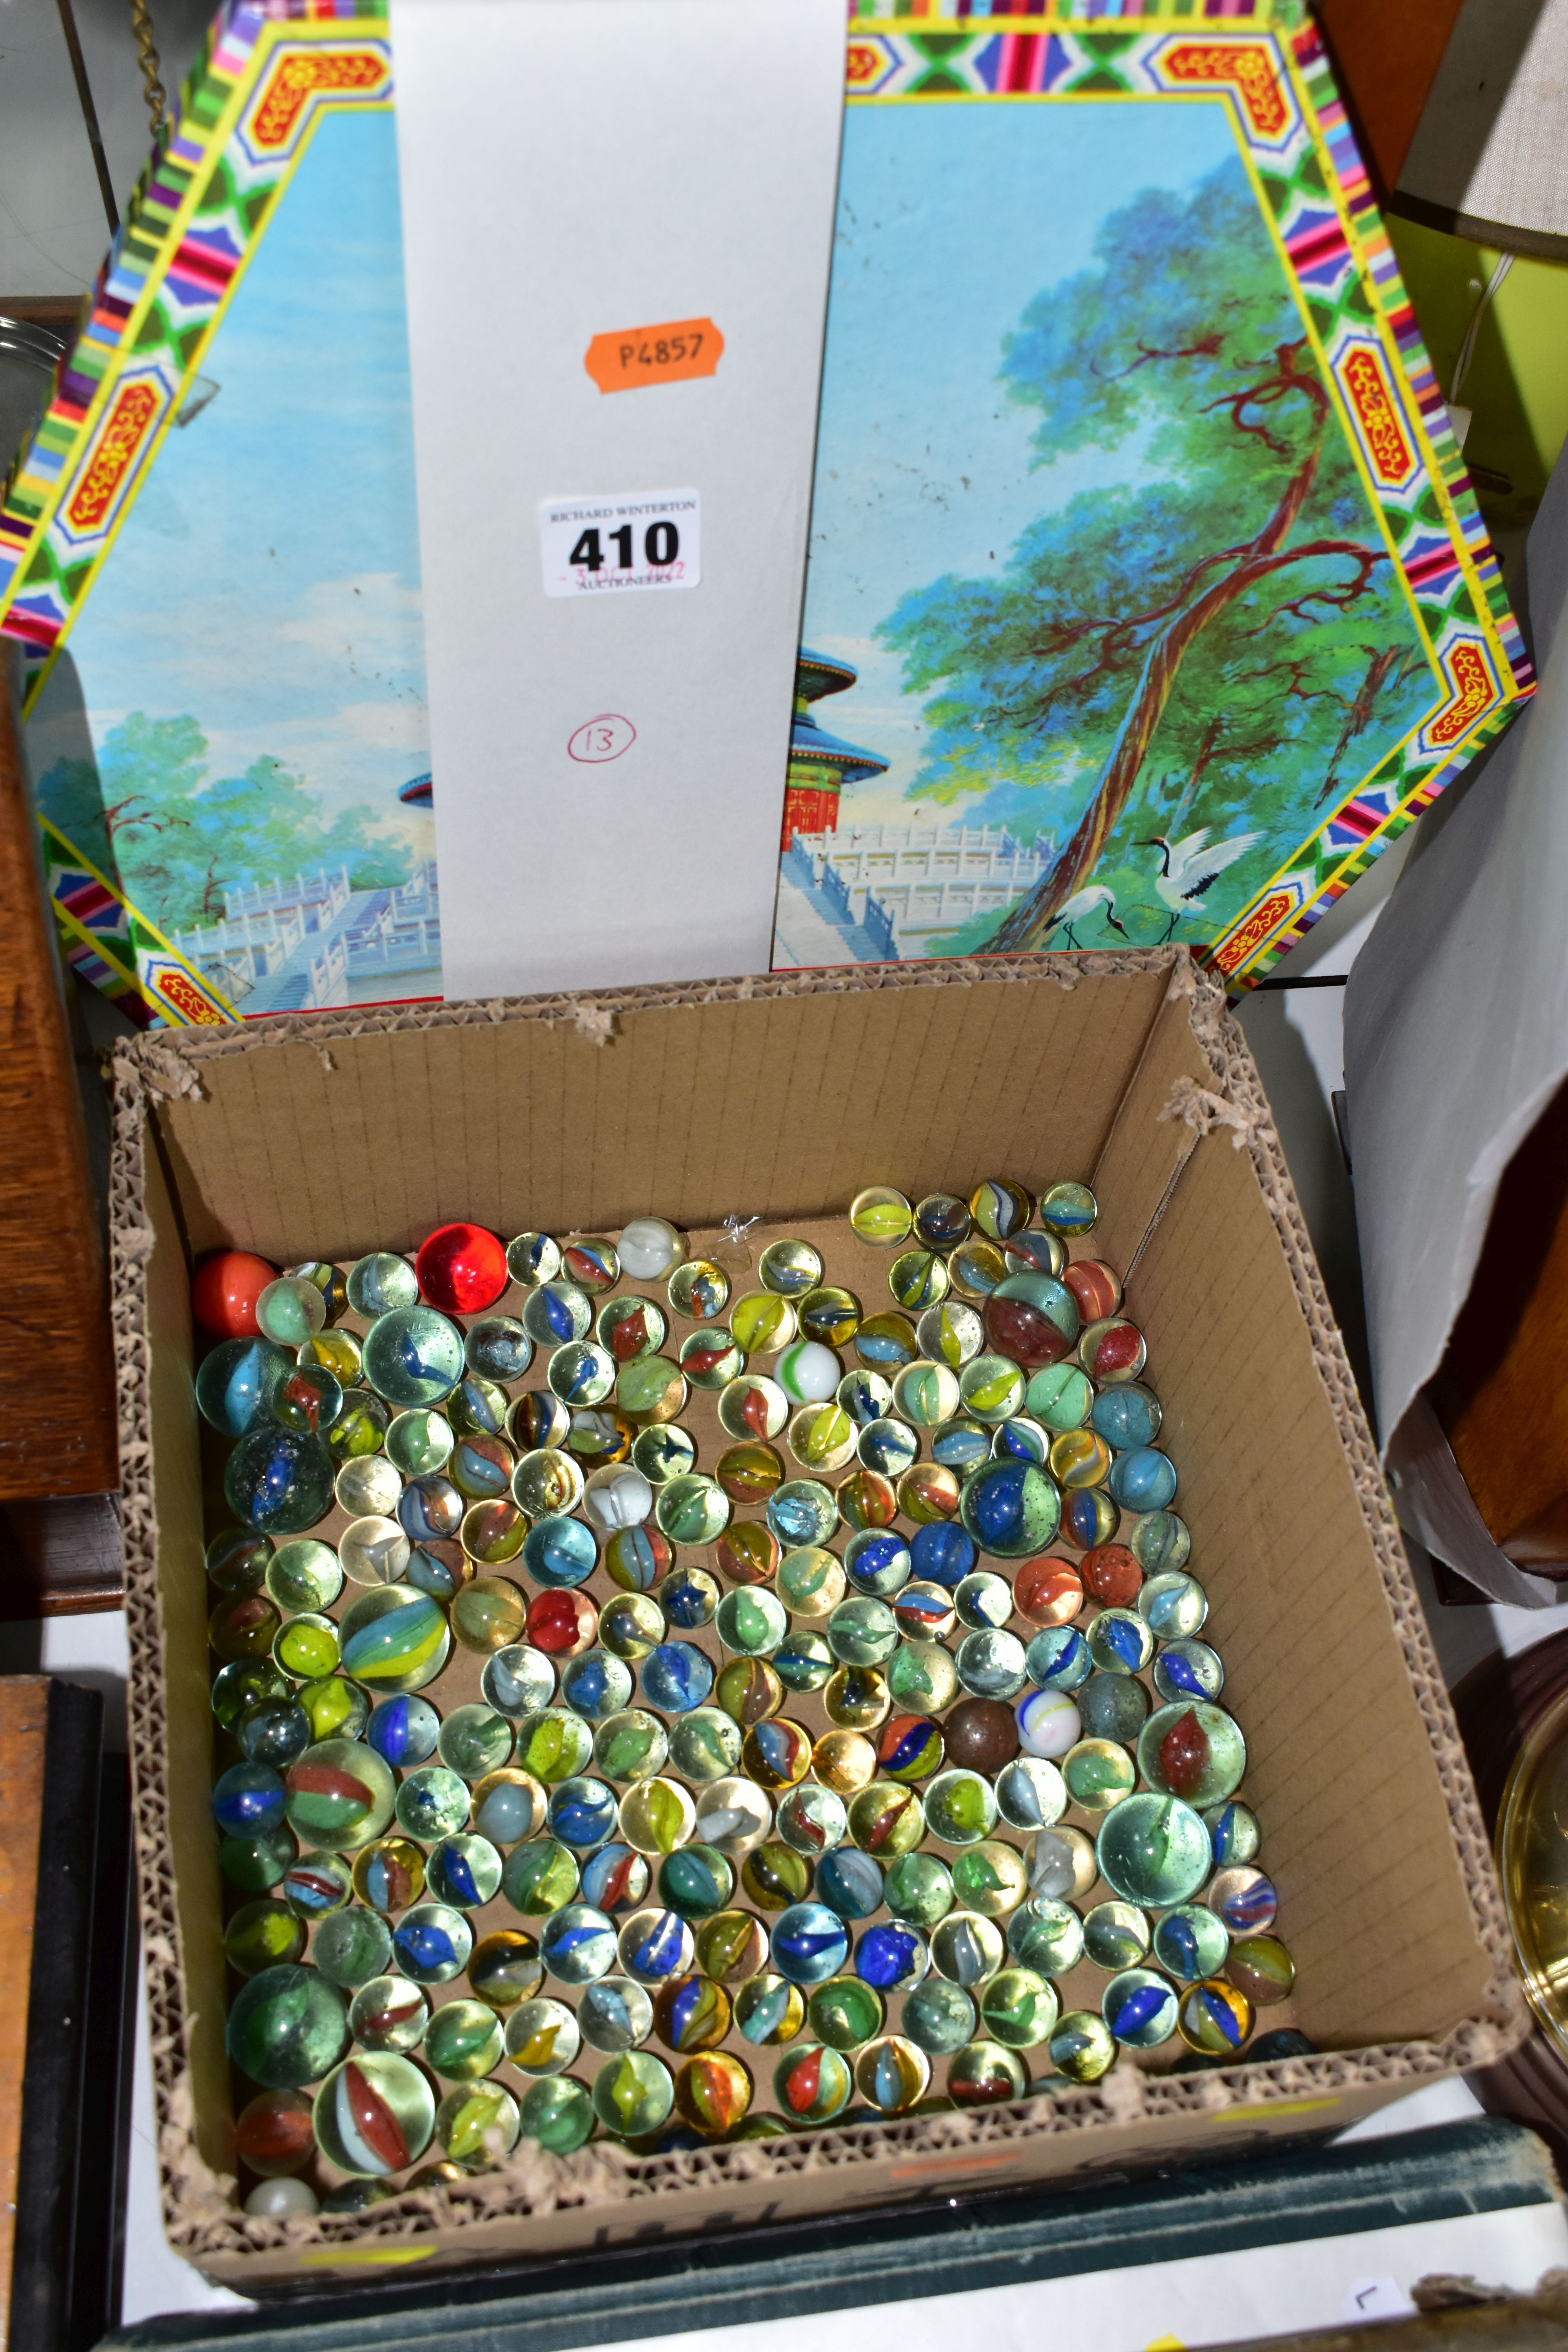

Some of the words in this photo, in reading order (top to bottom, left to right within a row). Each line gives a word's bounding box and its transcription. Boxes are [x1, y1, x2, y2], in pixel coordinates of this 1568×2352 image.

[619, 333, 703, 368] P4857
[550, 508, 613, 523] RICHARD
[616, 501, 696, 515] WINTERTON
[570, 520, 679, 572] 410
[579, 574, 672, 591] AUCTIONEERS
[586, 728, 613, 751] 13
